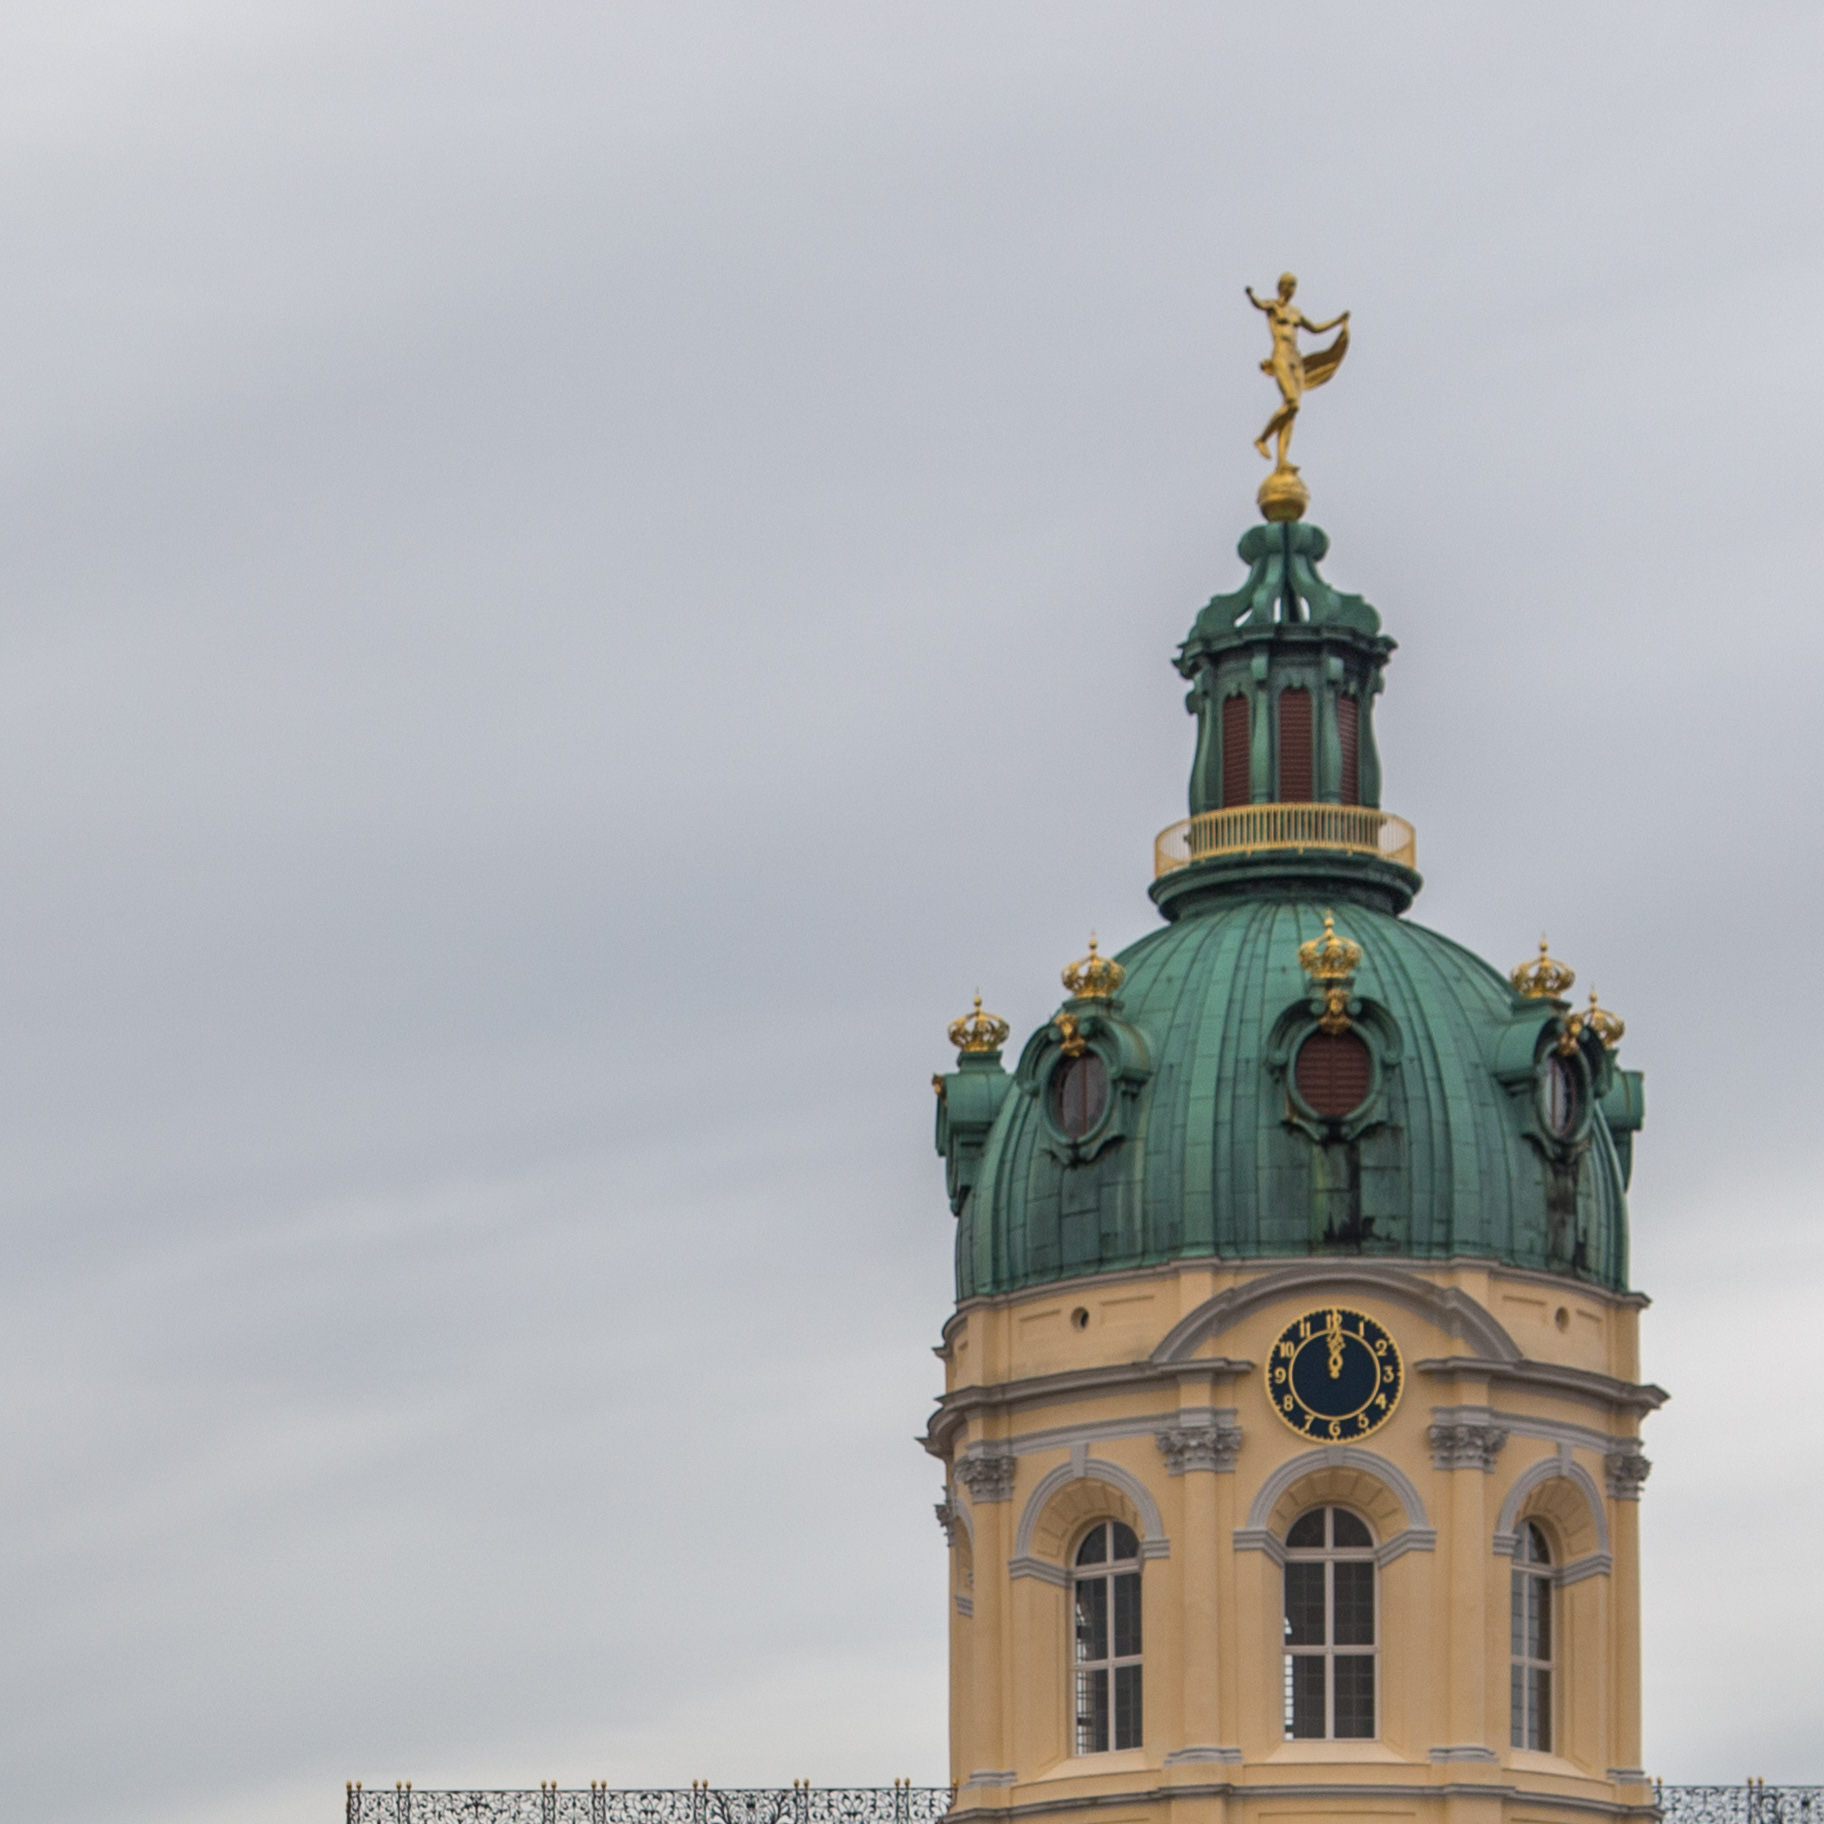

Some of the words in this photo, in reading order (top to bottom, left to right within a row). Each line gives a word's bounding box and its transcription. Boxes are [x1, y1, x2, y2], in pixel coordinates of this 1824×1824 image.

[1300, 1321, 1310, 1337] 11
[1359, 1321, 1364, 1335] 1
[1280, 1342, 1294, 1357] 10
[1375, 1340, 1387, 1356] 2
[1275, 1368, 1286, 1384] 9
[1383, 1366, 1394, 1383] 3
[1283, 1395, 1293, 1411] 8
[1375, 1394, 1386, 1410] 4
[1304, 1415, 1315, 1431] 7
[1329, 1422, 1341, 1436] 6
[1358, 1413, 1369, 1429] 5
